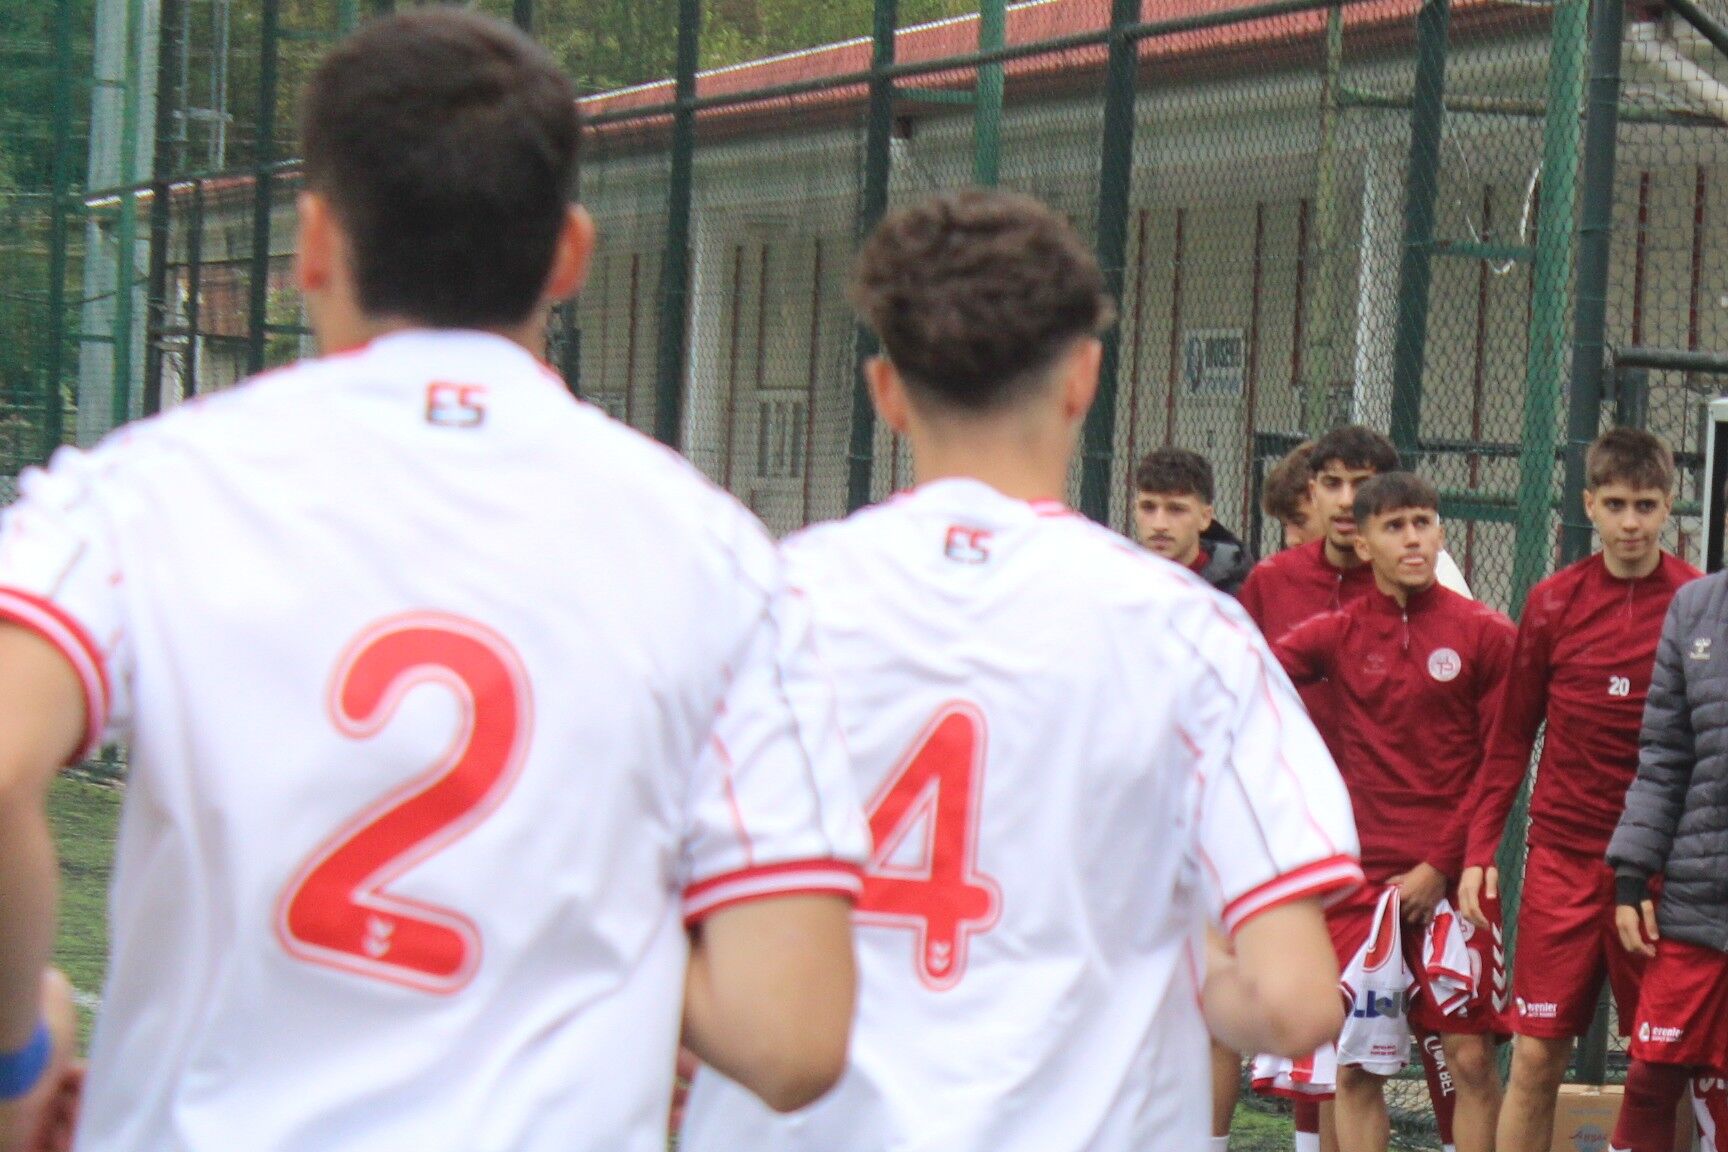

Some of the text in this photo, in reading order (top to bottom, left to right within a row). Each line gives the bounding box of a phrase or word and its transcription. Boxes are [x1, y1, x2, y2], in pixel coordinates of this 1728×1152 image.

[272, 609, 535, 996] 2
[1607, 675, 1631, 697] 20
[853, 699, 1001, 991] 4
